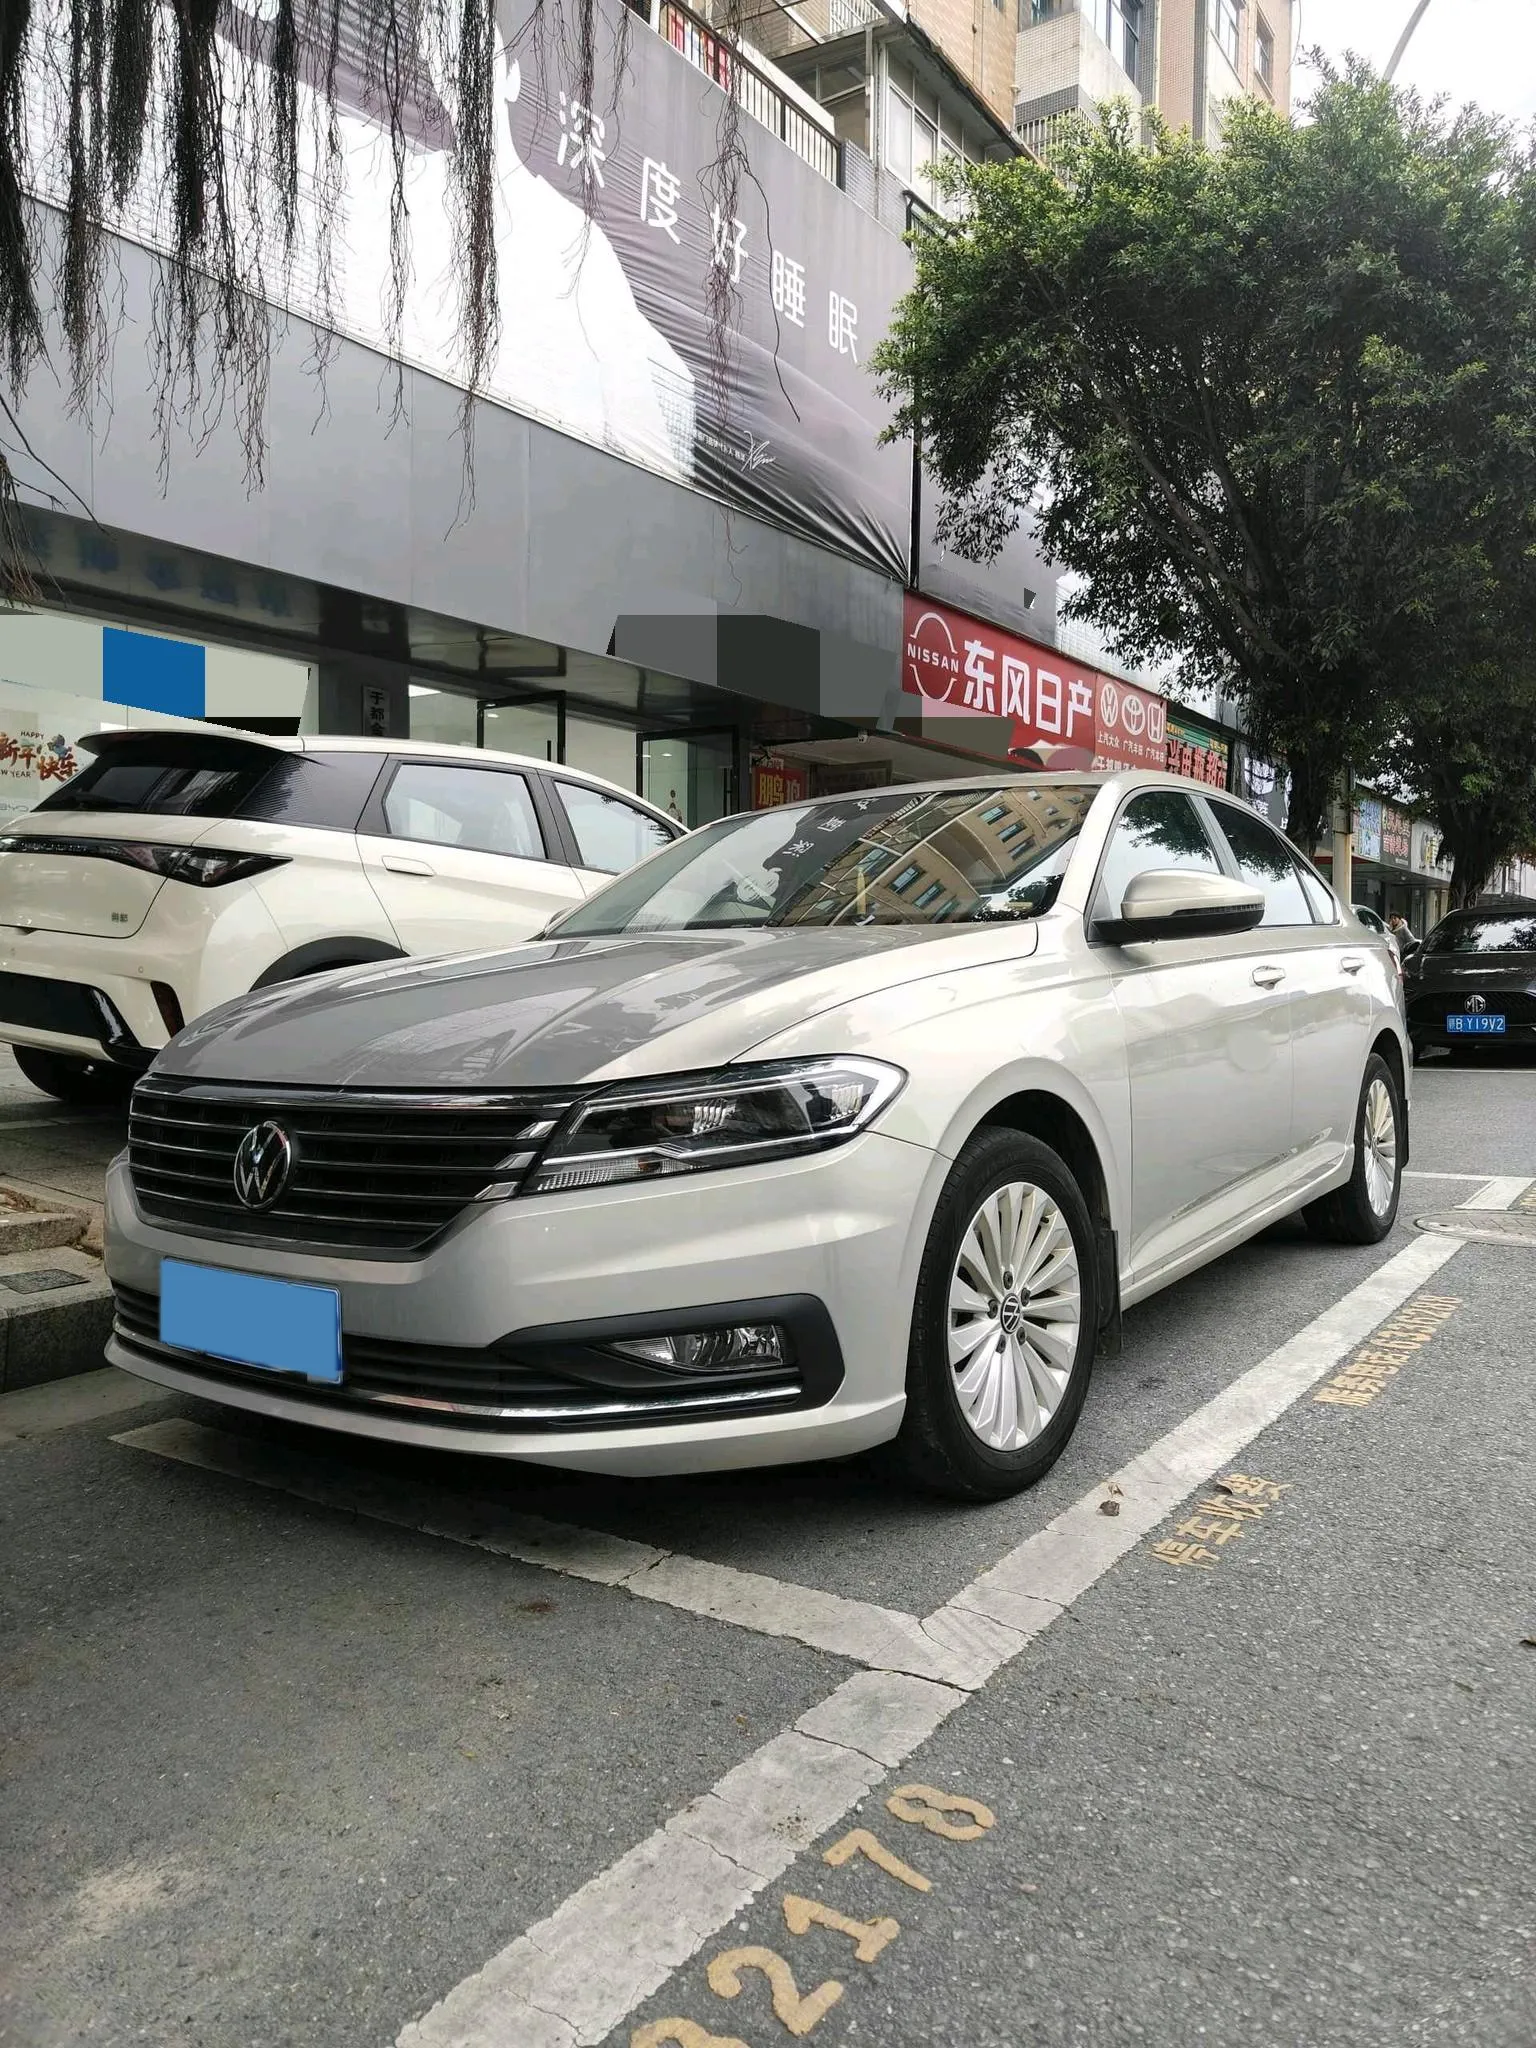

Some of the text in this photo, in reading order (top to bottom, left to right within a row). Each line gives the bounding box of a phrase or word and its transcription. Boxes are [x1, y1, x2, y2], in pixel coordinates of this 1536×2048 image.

[556, 91, 859, 363] 深度好睡眠
[907, 642, 959, 674] NISSAN
[963, 639, 1092, 738] 东风日产
[20, 731, 44, 740] HAPPY
[1097, 730, 1120, 749] 上汽大众
[10, 769, 31, 779] YEAR
[1465, 995, 1486, 1013] MG
[1146, 1473, 1293, 1570] 停车收费
